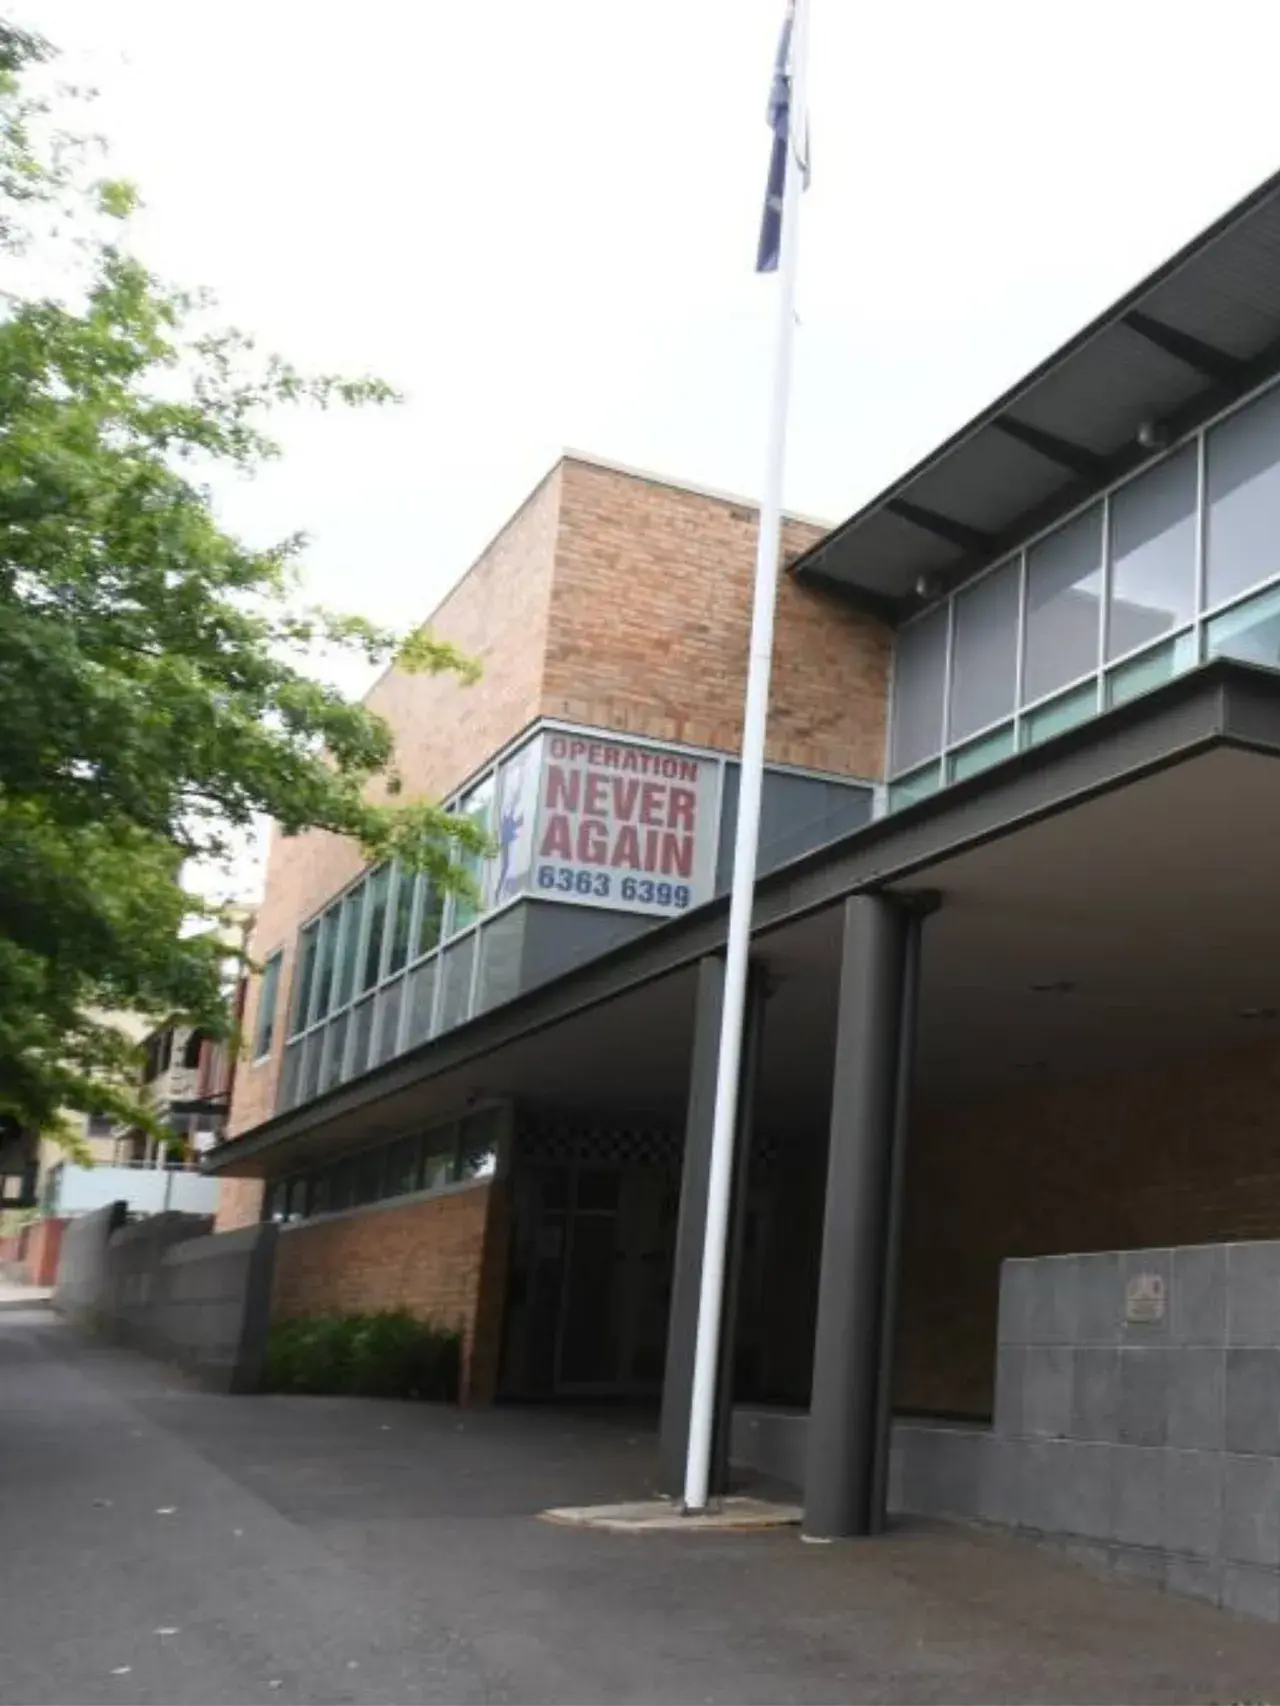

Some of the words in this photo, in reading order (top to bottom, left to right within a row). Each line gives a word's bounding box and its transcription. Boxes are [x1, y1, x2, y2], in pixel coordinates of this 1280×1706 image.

[551, 736, 698, 783] OPERATION
[545, 764, 696, 832] NEVER
[539, 814, 693, 879] AGAIN
[538, 865, 611, 898] 6363
[621, 875, 690, 909] 6399
